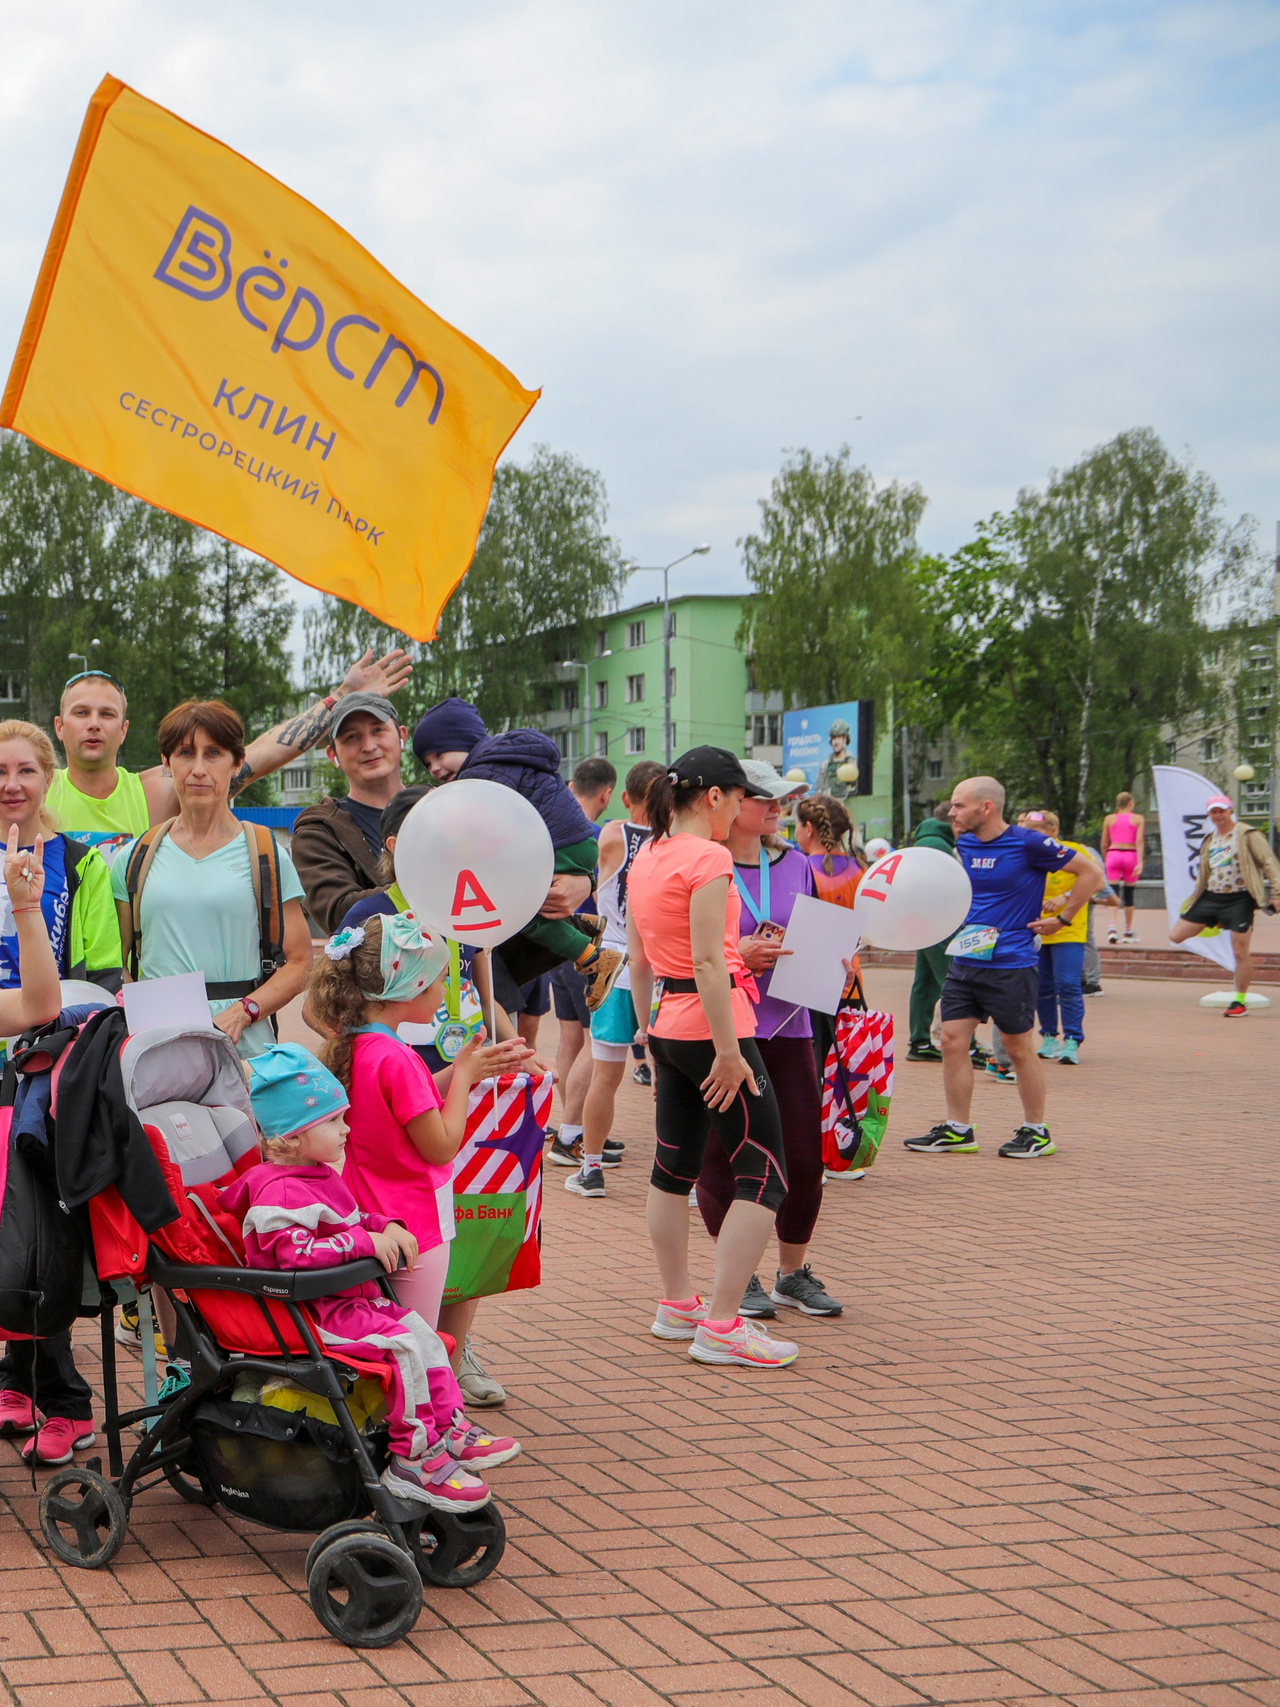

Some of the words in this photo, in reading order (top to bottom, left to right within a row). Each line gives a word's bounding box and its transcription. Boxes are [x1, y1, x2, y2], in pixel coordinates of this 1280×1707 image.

[213, 378, 336, 461] КЛИН
[119, 391, 319, 505] СЕСТРОРЕЦКИЙ
[326, 497, 385, 546] ПАРК
[960, 935, 981, 949] 155
[454, 1205, 474, 1223] фа
[478, 1205, 513, 1220] Банк
[263, 1285, 289, 1294] espresso
